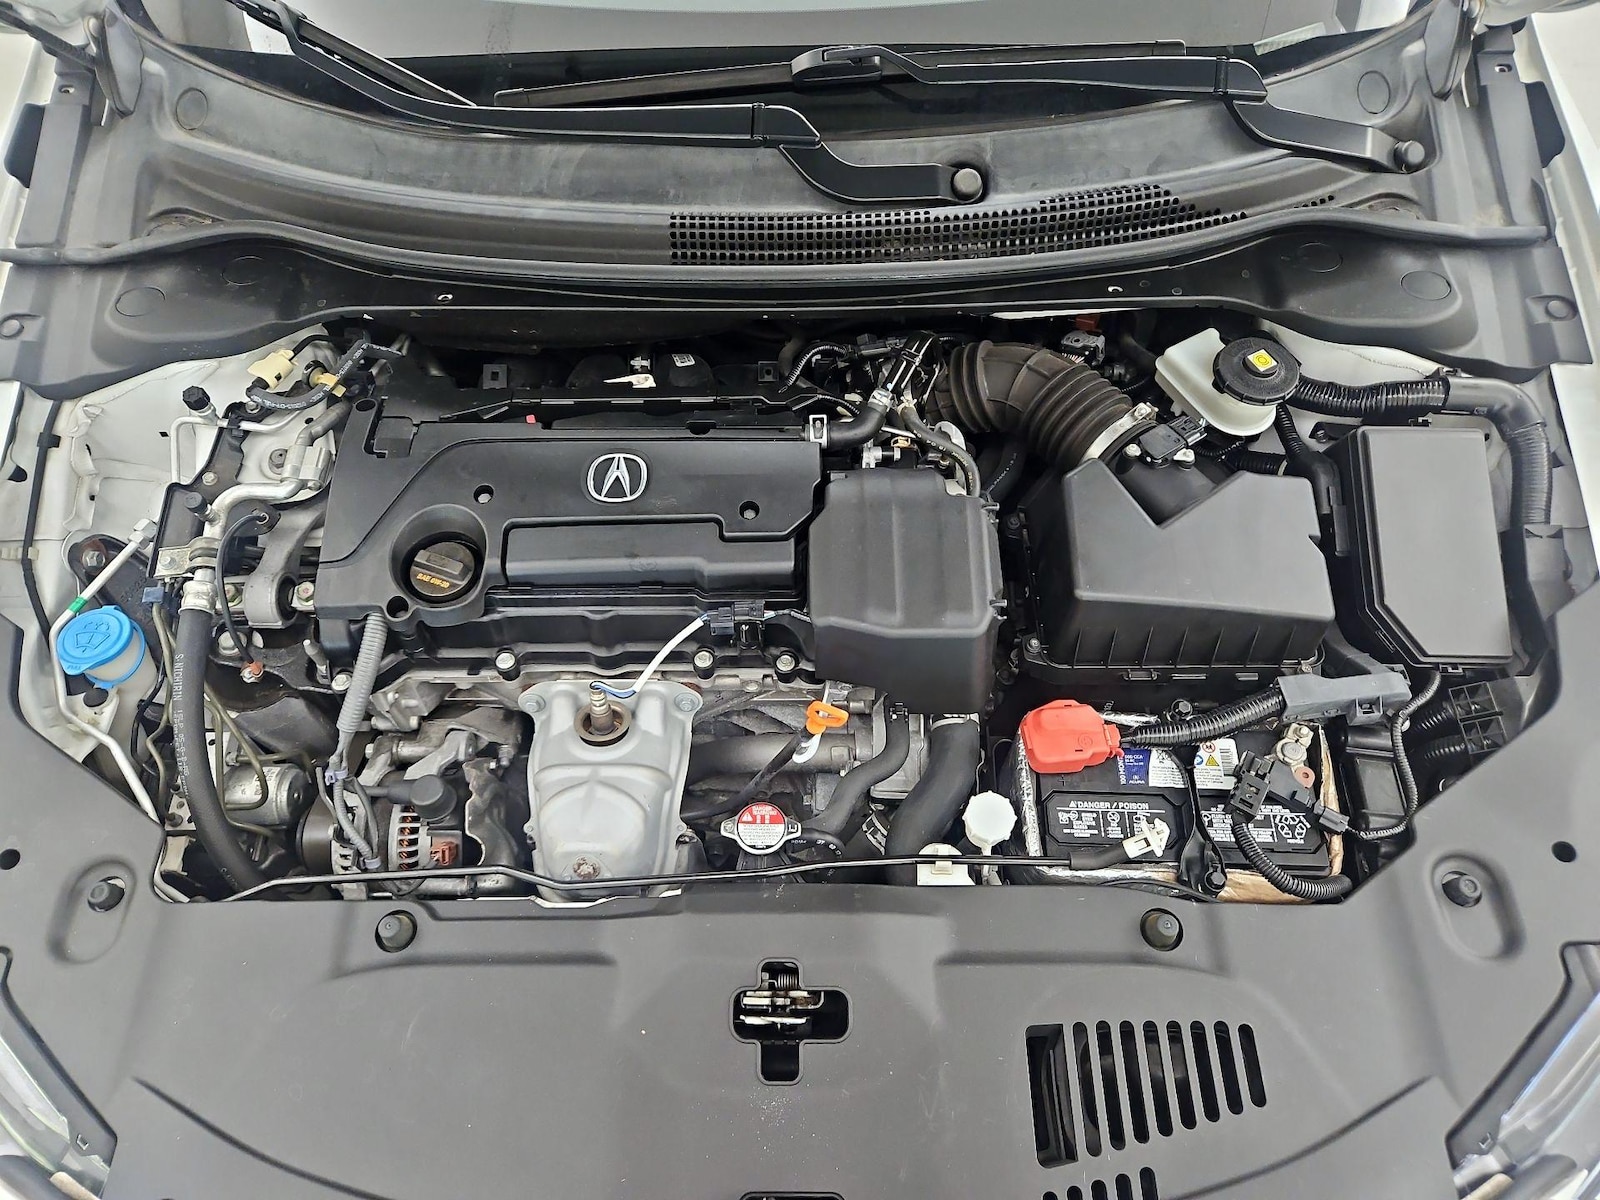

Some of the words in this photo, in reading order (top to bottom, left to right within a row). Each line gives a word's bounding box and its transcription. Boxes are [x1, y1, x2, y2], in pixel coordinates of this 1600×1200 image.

[416, 572, 430, 582] SAE
[430, 577, 450, 589] 0W-20
[1077, 801, 1110, 809] DANGER
[1119, 802, 1149, 810] POISON
